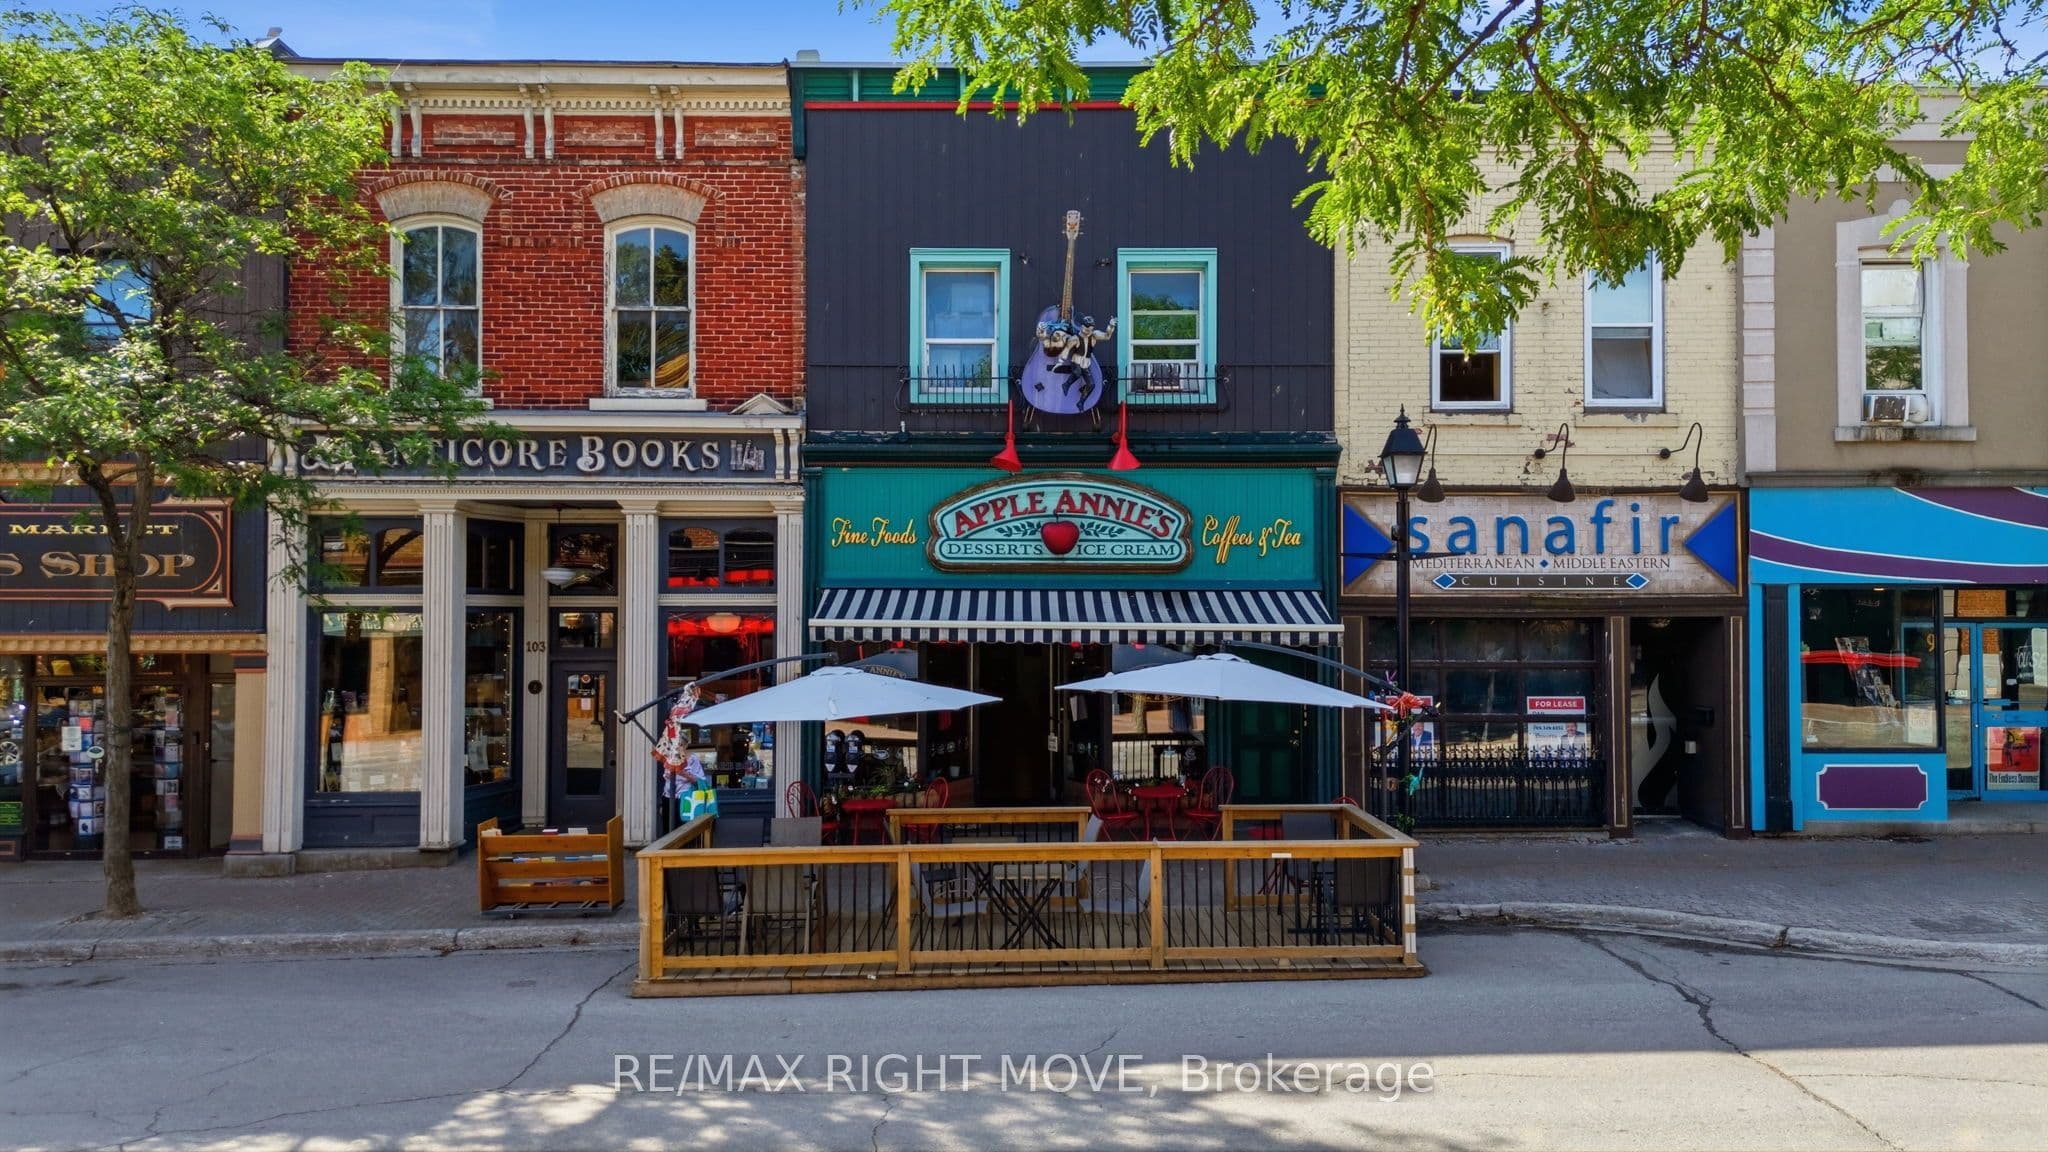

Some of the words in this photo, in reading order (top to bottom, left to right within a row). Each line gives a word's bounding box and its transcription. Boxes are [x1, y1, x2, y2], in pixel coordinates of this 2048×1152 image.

[576, 436, 719, 472] BOOKS
[954, 491, 1047, 537] APPLE
[1056, 489, 1176, 538] ANNIE'S
[8, 524, 178, 535] MART
[831, 517, 868, 547] Fine
[870, 517, 917, 547] Foods
[1408, 499, 1680, 555] sanafir
[1202, 514, 1254, 564] Coffees
[1259, 526, 1272, 557] &
[1272, 518, 1302, 548] Tea
[947, 543, 1043, 556] DESSERTS
[1077, 544, 1106, 556] ICE
[1110, 544, 1175, 556] CREAM
[1412, 557, 1535, 569] MEDITERRANEAN
[1553, 557, 1606, 569] MIDDLE
[1610, 557, 1671, 569] EASTERN
[1461, 576, 1620, 586] CUISINE
[526, 641, 546, 653] 103
[1535, 700, 1552, 708] FOR
[1552, 700, 1578, 708] LEASE
